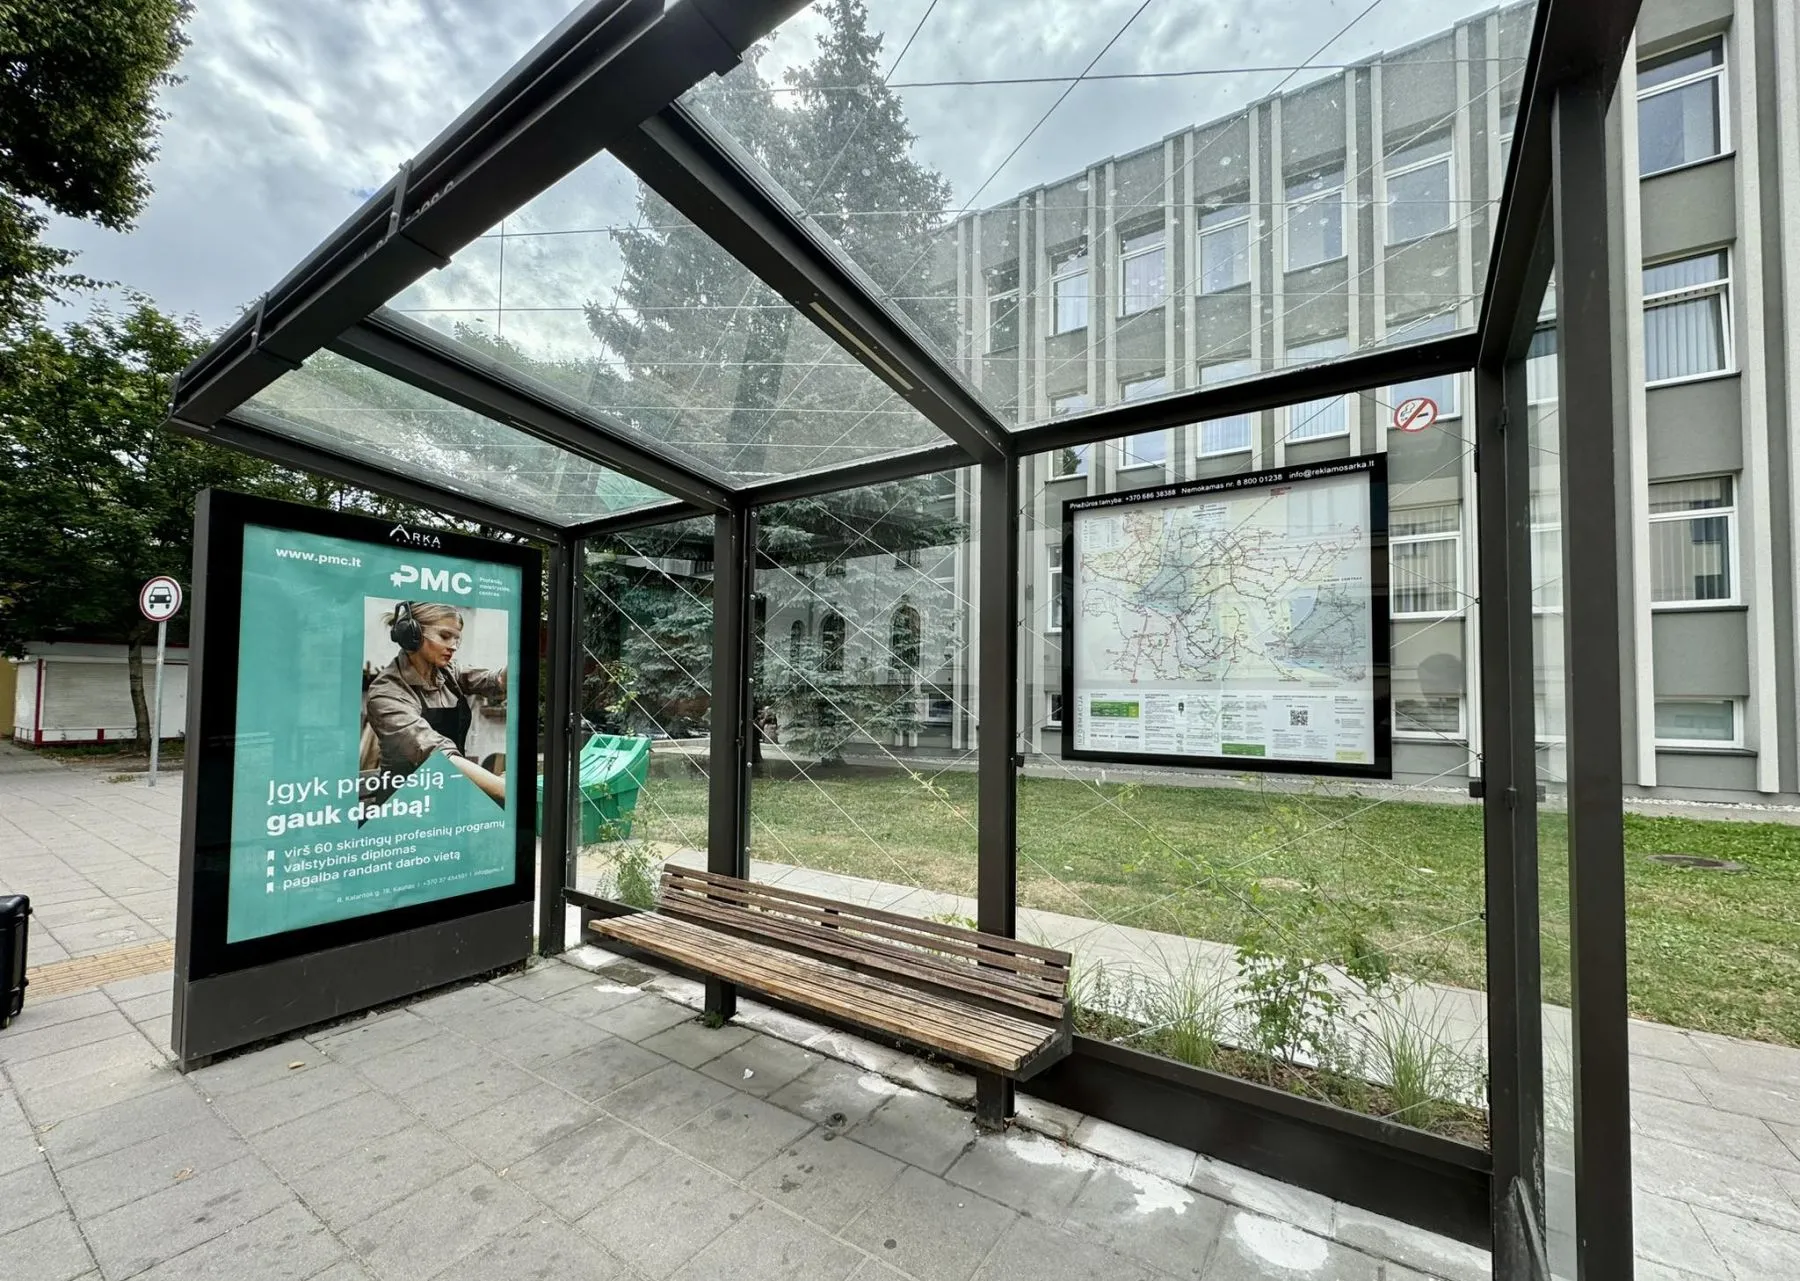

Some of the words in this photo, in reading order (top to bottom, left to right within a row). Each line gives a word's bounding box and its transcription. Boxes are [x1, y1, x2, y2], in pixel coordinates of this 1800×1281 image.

[1181, 482, 1224, 494] Nemokamas
[1243, 477, 1258, 485] 800
[1258, 473, 1283, 483] 01238
[1288, 460, 1375, 479] info@reklamosarka.lt
[1125, 494, 1141, 502] +370
[389, 523, 441, 545] ARKA
[275, 548, 362, 568] www.pmc.lt
[389, 564, 473, 595] PMC
[266, 777, 329, 805] Įgyk
[337, 768, 444, 797] profesiją
[266, 804, 342, 836] gauk
[347, 795, 431, 819] darbą!
[284, 844, 311, 859] virš
[314, 842, 333, 854] 60
[336, 834, 392, 851] skirtingų
[395, 825, 453, 844] profesinių
[455, 819, 505, 836] programų
[282, 871, 340, 891] pagalba
[343, 861, 393, 879] randant
[395, 855, 431, 869] darbo
[433, 849, 462, 863] vietą
[283, 854, 358, 874] valstybinis
[361, 845, 417, 863] diplomas
